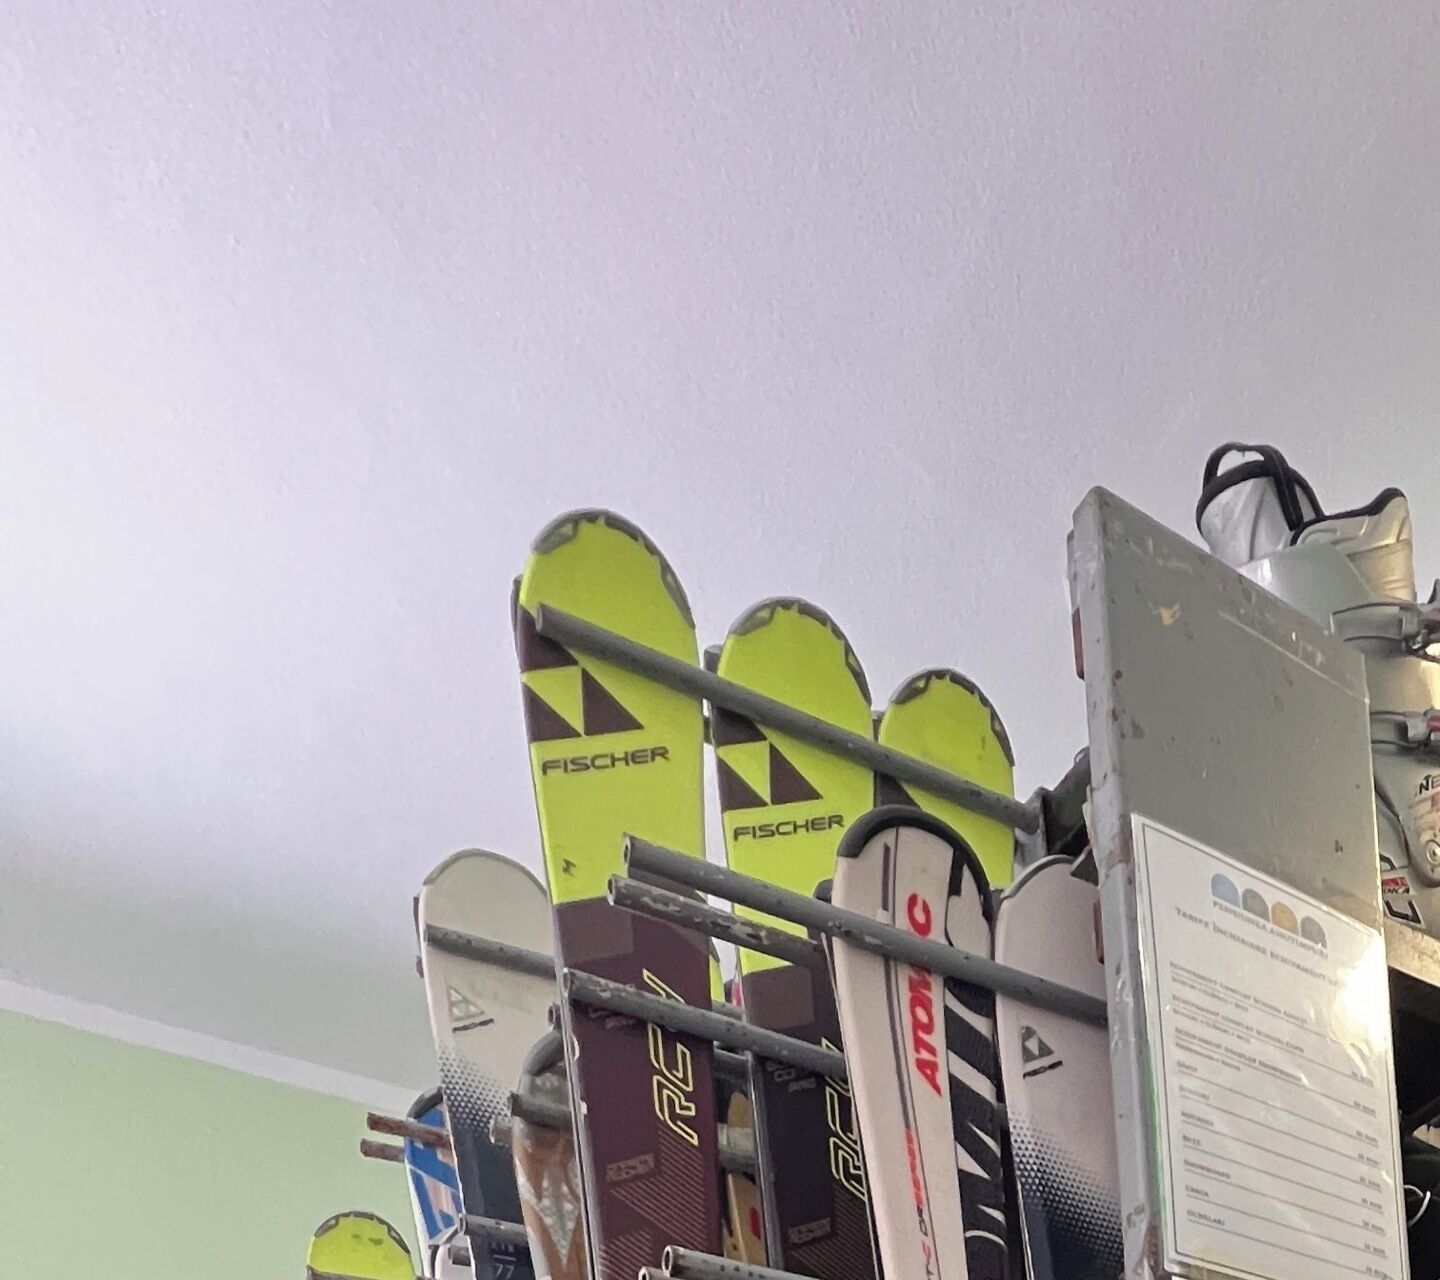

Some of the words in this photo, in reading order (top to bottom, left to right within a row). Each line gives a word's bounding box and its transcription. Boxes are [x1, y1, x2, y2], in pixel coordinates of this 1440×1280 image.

[541, 745, 670, 776] FISCHER
[733, 814, 846, 841] FISCHER
[906, 892, 943, 1099] ATOMC
